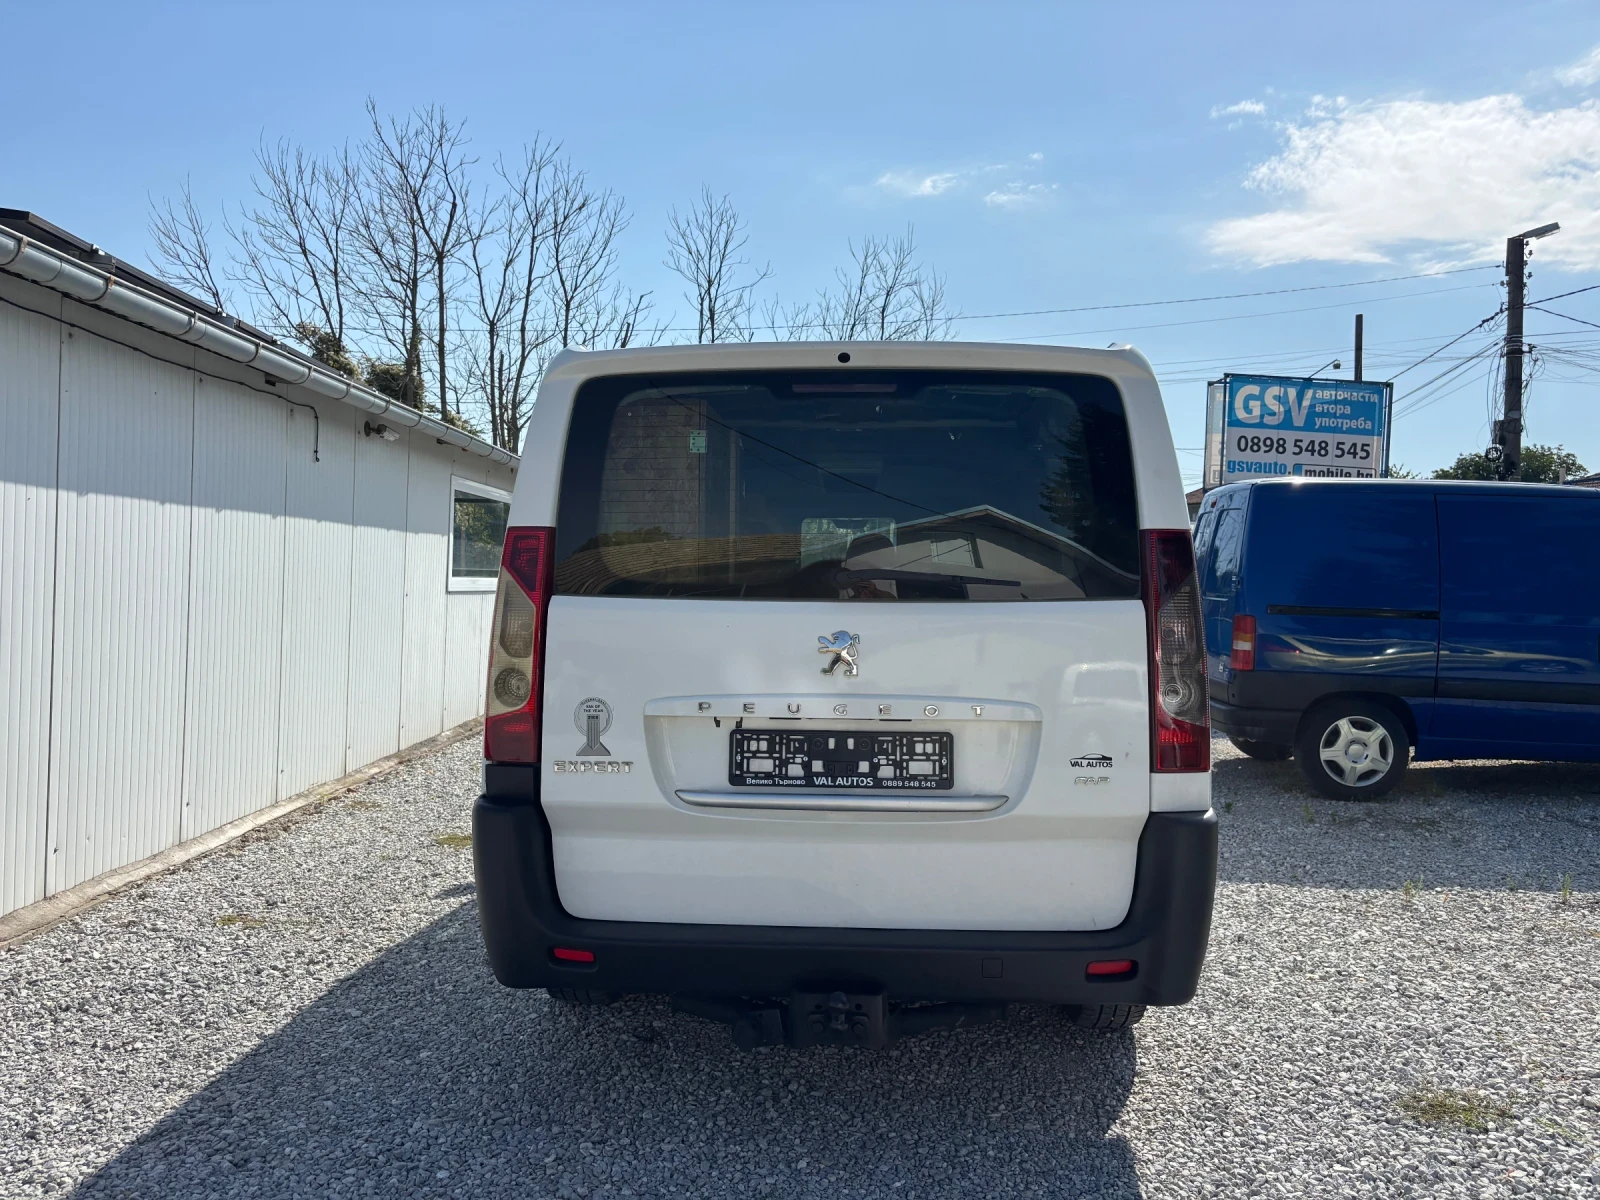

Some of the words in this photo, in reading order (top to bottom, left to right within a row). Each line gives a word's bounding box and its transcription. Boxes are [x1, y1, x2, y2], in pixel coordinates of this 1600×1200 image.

[1315, 389, 1378, 402] авточасти
[1234, 384, 1313, 427] GSV
[1315, 403, 1351, 415] втора
[1314, 416, 1372, 430] употреба
[1237, 435, 1287, 455] 0898
[1292, 439, 1329, 457] 548
[1334, 441, 1371, 460] 545
[1304, 467, 1373, 478] mobileb
[698, 701, 985, 717] PEUGEOT
[553, 761, 634, 773] EXPERT
[1069, 760, 1085, 768] VAL
[746, 777, 773, 785] Велико
[774, 777, 806, 785] Търново
[813, 776, 834, 786] VAL
[835, 777, 874, 786] AUTOS
